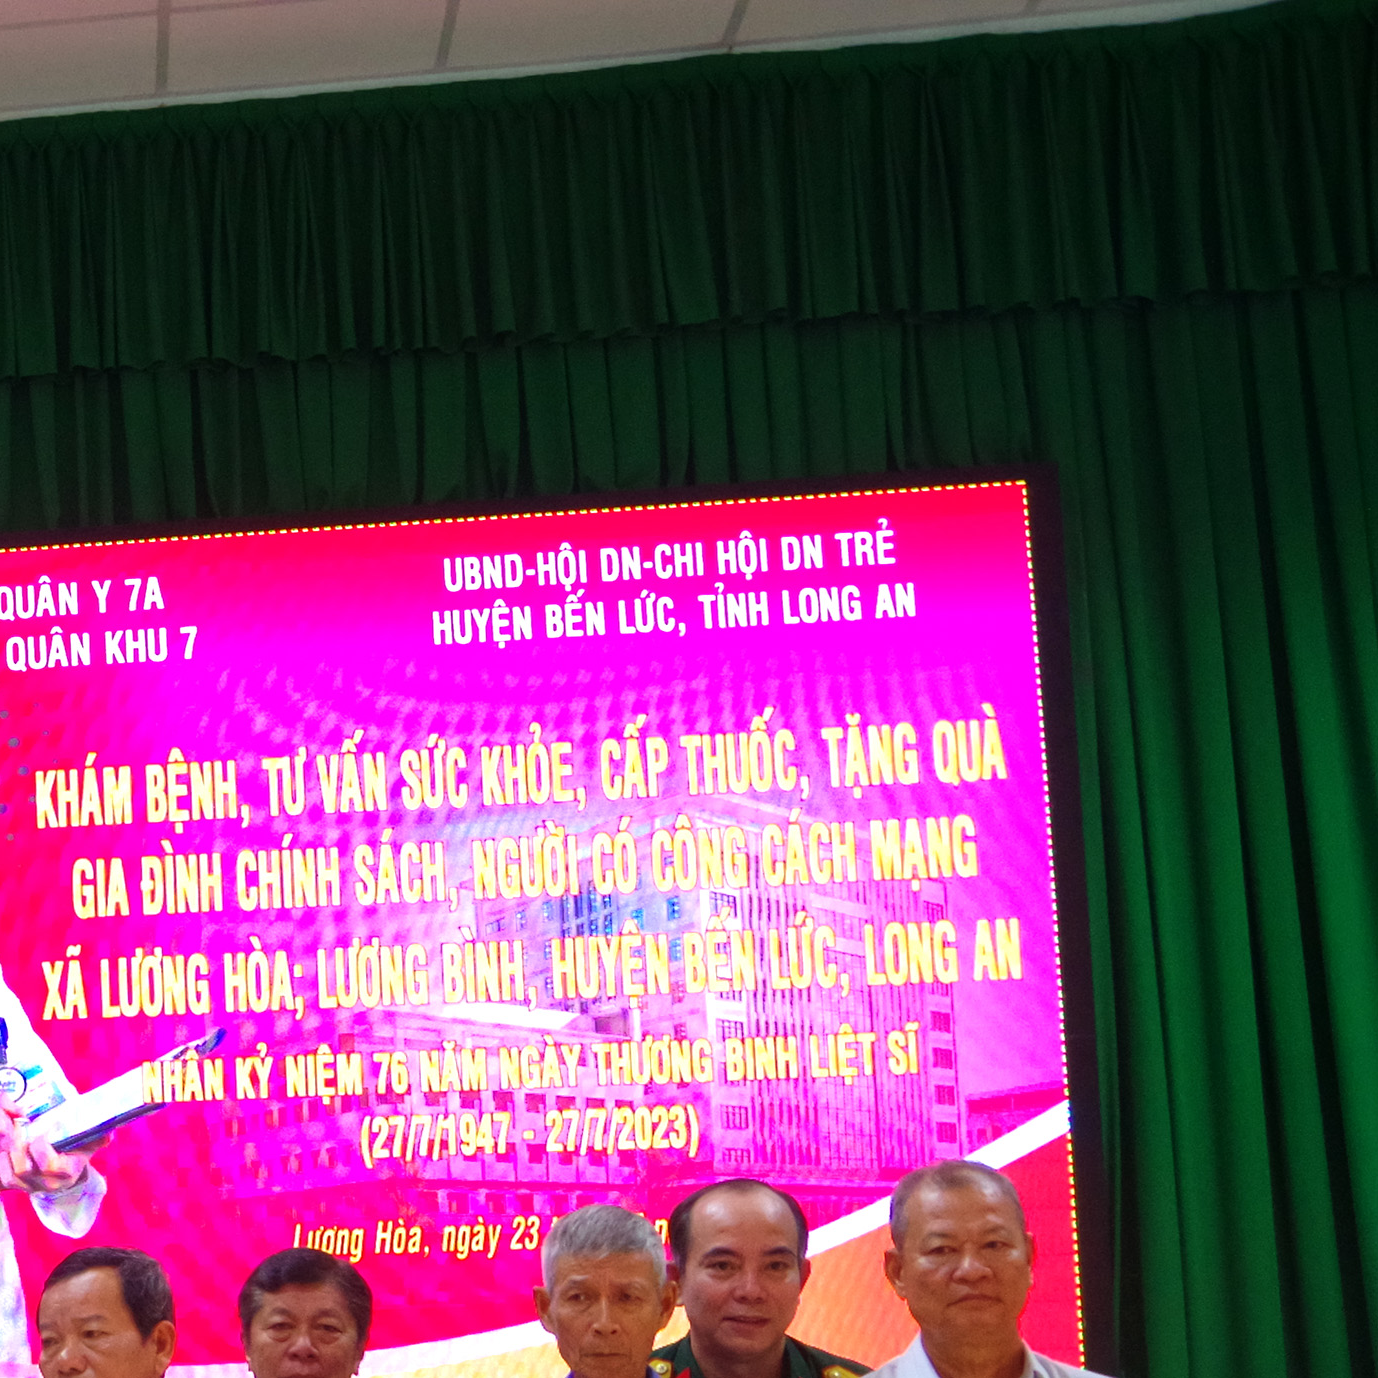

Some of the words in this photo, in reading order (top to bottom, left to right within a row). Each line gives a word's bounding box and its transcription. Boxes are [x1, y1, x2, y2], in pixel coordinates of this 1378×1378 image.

[444, 542, 588, 592] UBND-HỘI
[601, 542, 704, 582] DN-CHI
[717, 529, 767, 580] HỘI
[781, 535, 823, 571] DN
[835, 517, 896, 567] TRẺ
[92, 580, 112, 613] Y
[124, 576, 164, 610] 7A
[432, 598, 533, 649] HUYỆN
[545, 589, 606, 640] BẾN
[618, 589, 687, 637] LỨC,
[697, 582, 769, 630] TỈNH
[781, 585, 862, 626] LONG
[875, 582, 917, 620] AN
[6, 626, 90, 672] QUÂN
[105, 627, 168, 664] KHU
[180, 626, 198, 660] 7
[34, 751, 133, 829] KHÁM
[145, 746, 251, 834] BỆNH,
[262, 746, 307, 817] TƯ
[316, 729, 388, 815] VẤN
[399, 733, 469, 810] SỨC
[480, 721, 587, 811] KHỎE,
[600, 714, 669, 801] CẤP
[680, 706, 810, 799] THUỐC,
[821, 712, 920, 800] TẶNG
[933, 702, 1008, 786] QUÀ
[72, 858, 130, 920] GIA
[140, 839, 223, 916] ĐÌNH
[236, 833, 341, 911] CHÍNH
[353, 828, 458, 912] SÁCH,
[472, 820, 579, 900] NGƯỜI
[592, 816, 638, 896] CÓ
[651, 813, 750, 892] CÔNG
[761, 808, 858, 887] CÁCH
[870, 814, 978, 892] MẠNG
[41, 945, 88, 1021] XÃ
[100, 947, 211, 1018] LƯƠNG
[224, 936, 304, 1021] HÒA;
[316, 937, 429, 1009] LƯƠNG
[442, 926, 538, 1012] BÌNH,
[551, 918, 670, 1009] HUYỆN
[684, 906, 756, 994] BẾN
[768, 911, 850, 998] LỨC,
[863, 918, 960, 988] LONG
[973, 917, 1023, 982] AN
[142, 1048, 225, 1104] NHÂN
[235, 1042, 273, 1100] KỶ
[285, 1043, 363, 1105] NIỆM
[372, 1050, 409, 1095] 76
[419, 1041, 488, 1094] NĂM
[499, 1034, 581, 1090] NGÀY
[592, 1034, 714, 1086] THƯƠNG
[725, 1035, 799, 1083] BINH
[809, 1022, 877, 1086] LIỆT
[886, 1020, 921, 1076] SĨ
[360, 1111, 511, 1169] (27/7/1947
[523, 1129, 535, 1141] -
[545, 1104, 701, 1159] 27/7/2023)
[374, 1219, 431, 1258] Hòa,
[440, 1217, 503, 1260] ngày
[509, 1215, 541, 1252] 23
